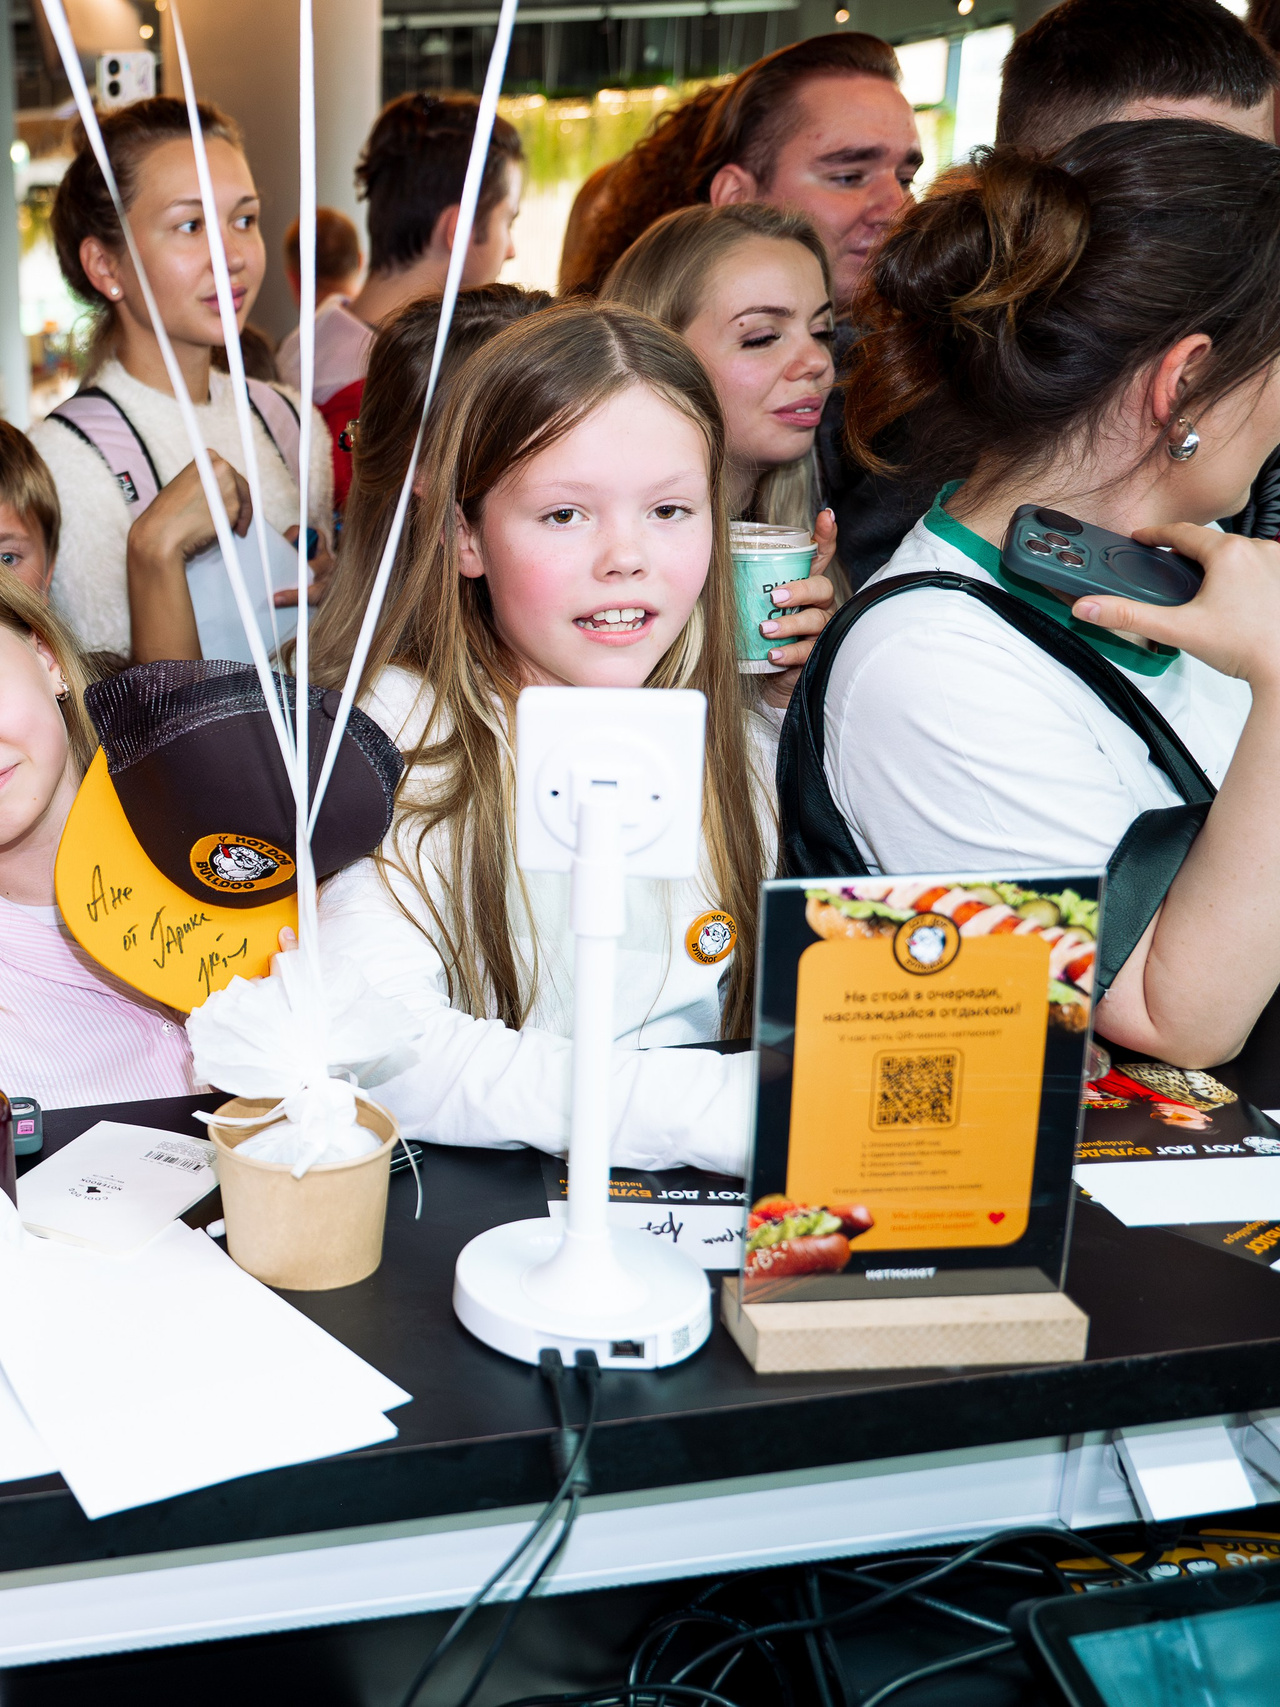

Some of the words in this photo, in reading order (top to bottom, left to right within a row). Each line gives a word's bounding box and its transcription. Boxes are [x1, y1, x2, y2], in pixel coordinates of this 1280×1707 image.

[235, 836, 268, 849] HOT
[267, 848, 292, 866] DOG
[196, 861, 255, 889] BULLDOG
[711, 914, 727, 922] ХОТ
[725, 920, 737, 935] ДОГ
[691, 942, 718, 963] БУЛЬДОГ
[844, 990, 867, 1003] Не
[870, 986, 910, 1001] стой
[914, 992, 922, 1000] в
[823, 1005, 935, 1023] наслаждайся
[939, 1003, 1022, 1019] отдыхом!
[1073, 1147, 1153, 1158] БУЛЬДО
[1156, 1145, 1197, 1156] ДОГ
[1202, 1143, 1247, 1154] ХОТ
[80, 1177, 123, 1192] NOTEBOOK
[657, 1189, 700, 1200] ДОГ
[706, 1190, 750, 1201] ХОТ
